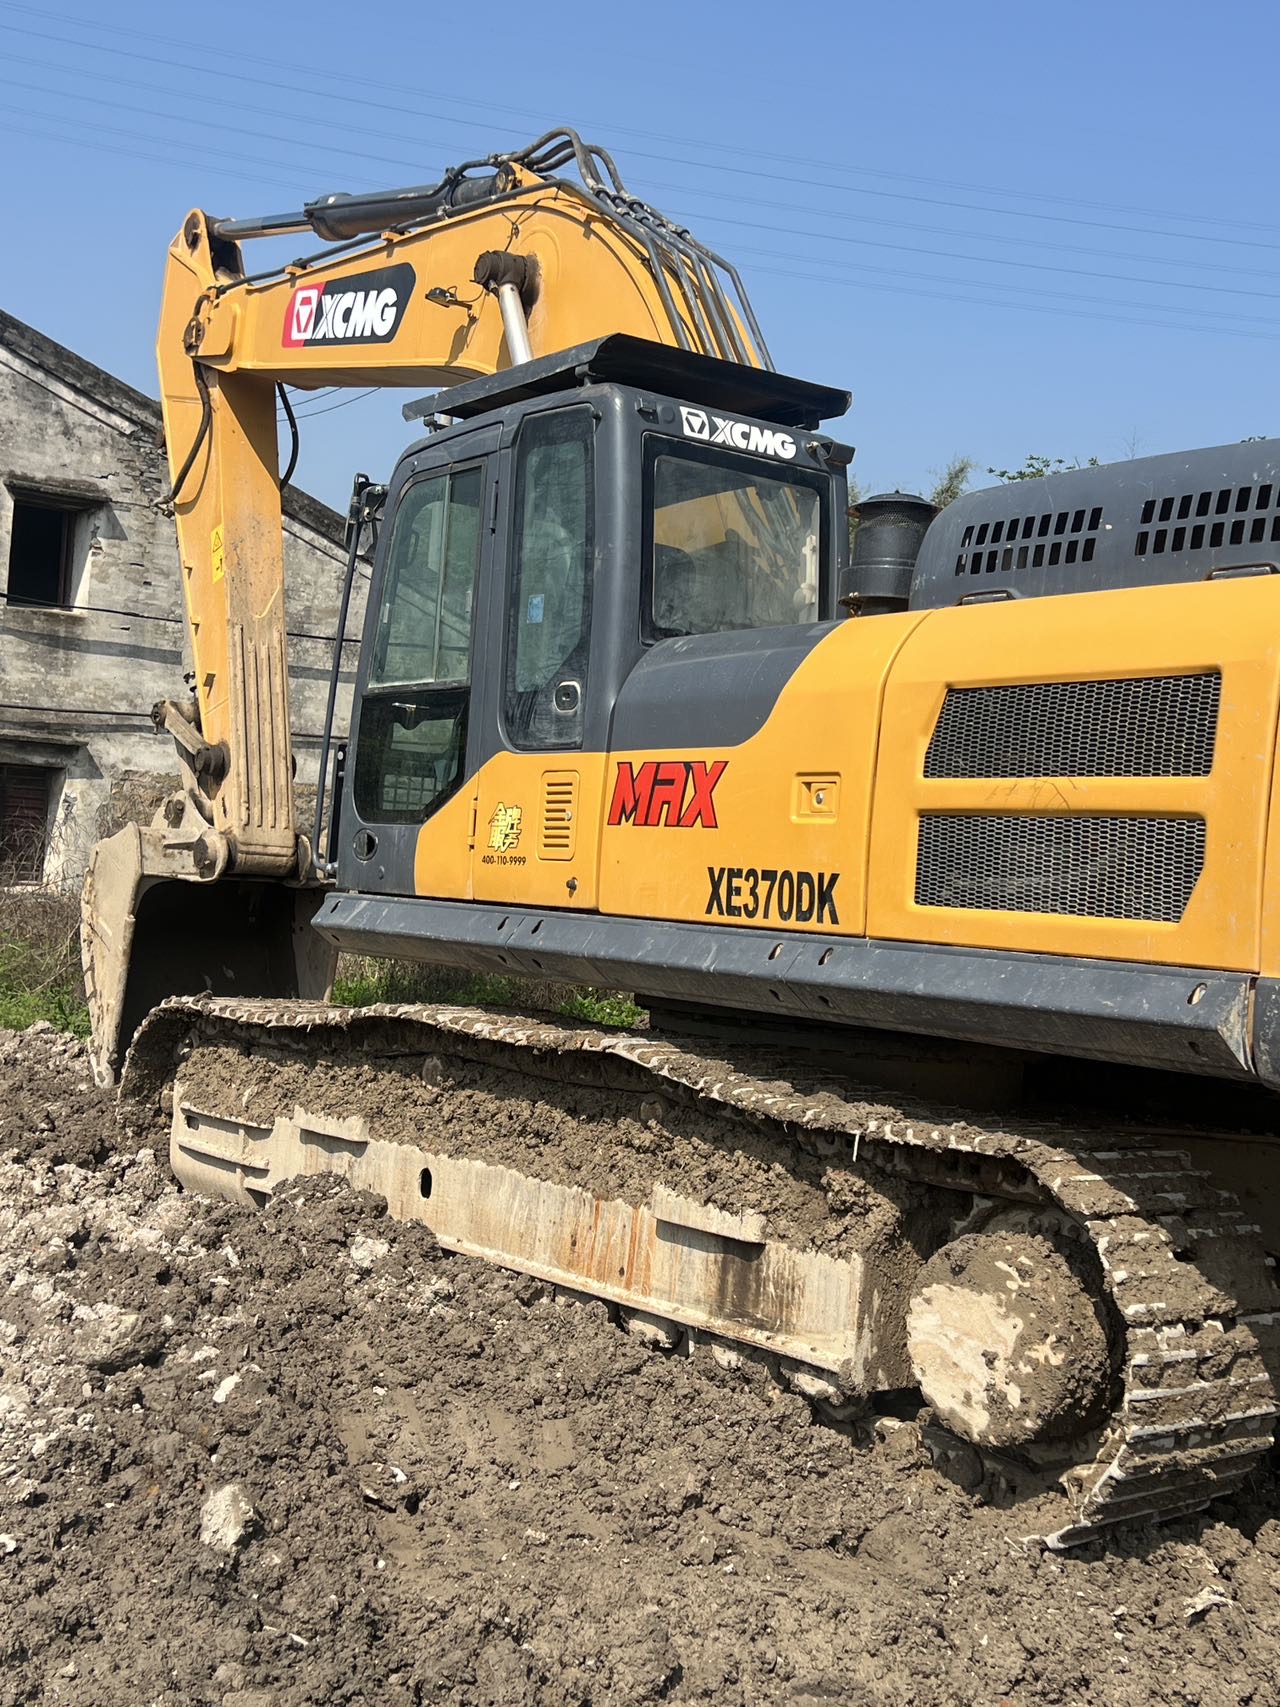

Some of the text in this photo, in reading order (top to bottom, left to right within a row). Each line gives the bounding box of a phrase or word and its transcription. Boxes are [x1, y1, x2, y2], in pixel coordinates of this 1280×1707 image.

[312, 287, 397, 340] XCMG
[710, 416, 797, 459] XCMG
[607, 761, 730, 829] MAX
[481, 855, 527, 866] 400-110-9999
[705, 866, 840, 925] XE370DK
